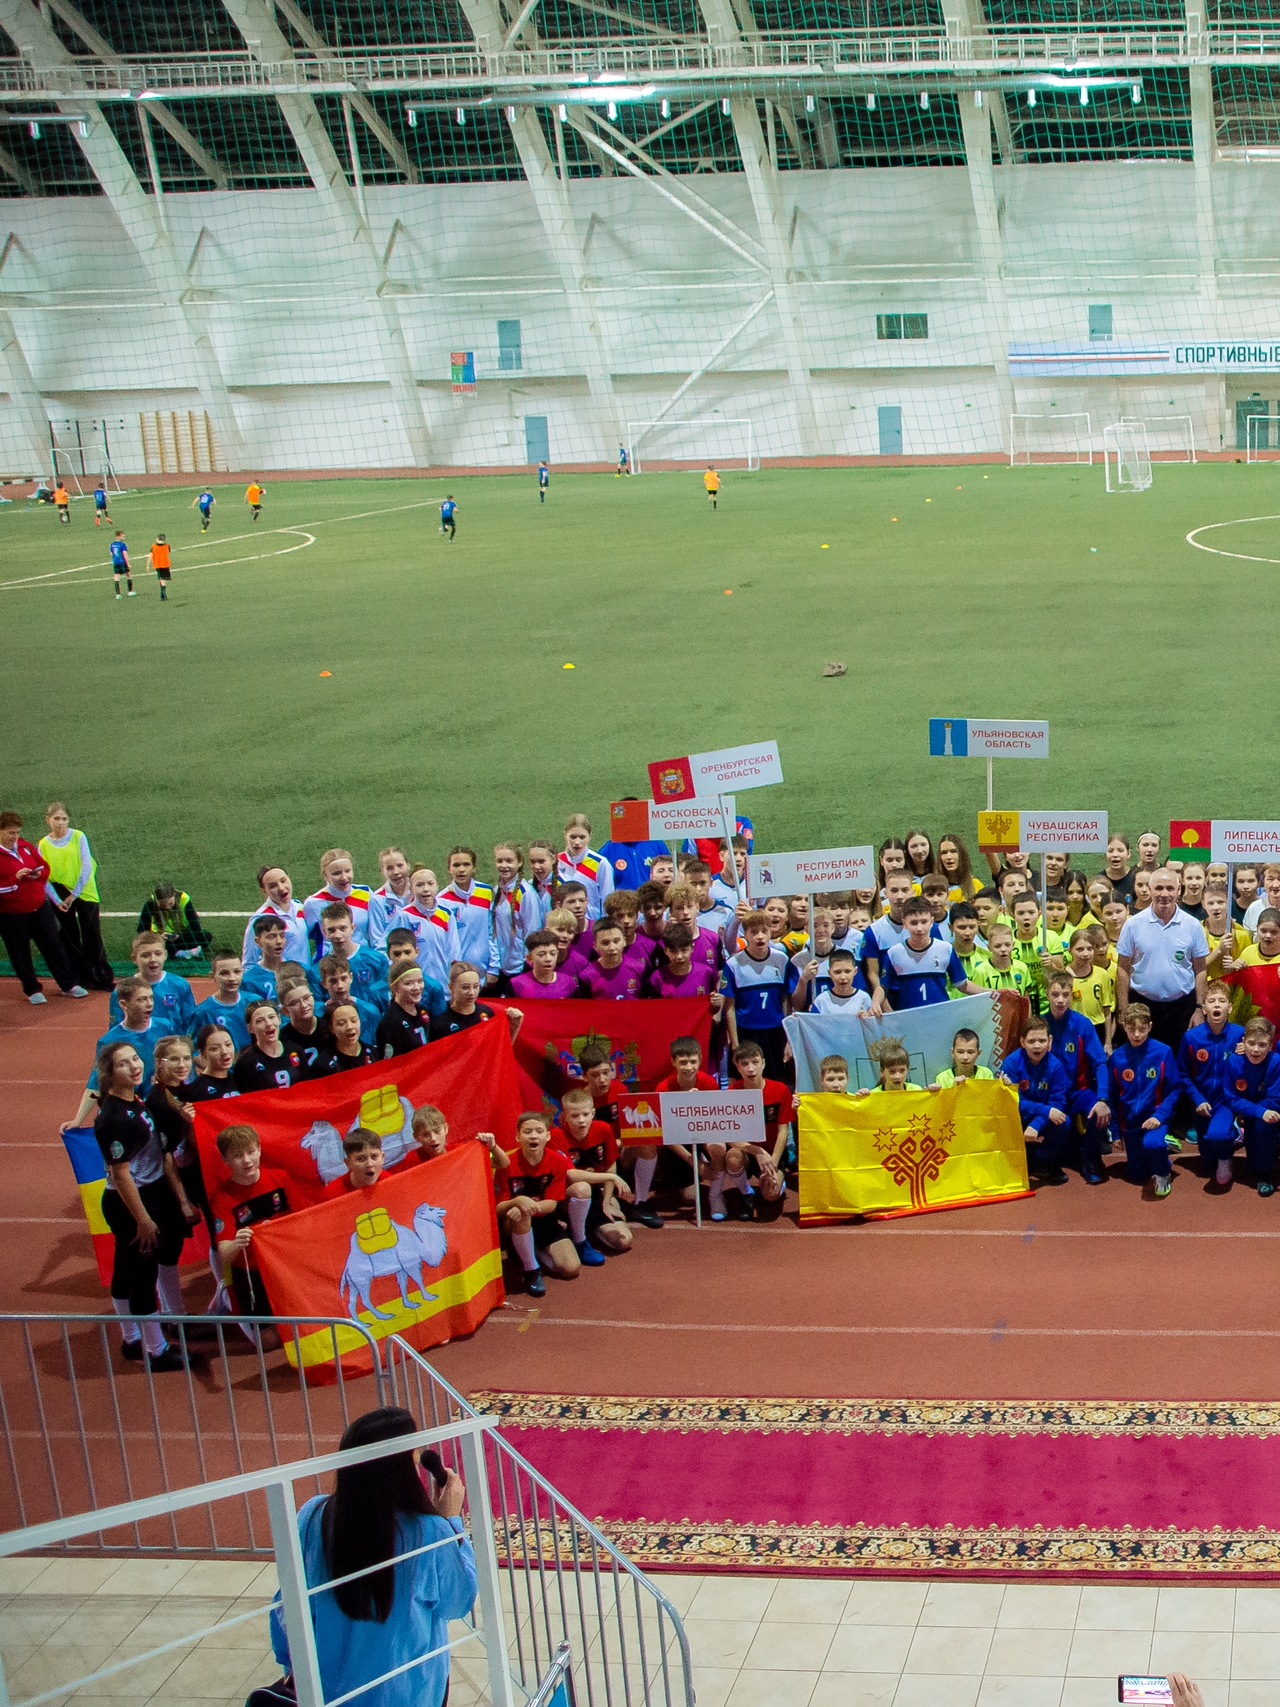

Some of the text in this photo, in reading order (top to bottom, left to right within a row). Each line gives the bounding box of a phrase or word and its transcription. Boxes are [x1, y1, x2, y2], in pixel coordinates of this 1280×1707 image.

[972, 730, 1045, 739] УЛЬЯНОВСКАЯ
[984, 740, 1031, 749] ОБЛАСТЬ
[700, 754, 774, 774] ОРЕНБУРГСКАЯ
[717, 768, 761, 782] ОБЛАСТЬ
[664, 819, 717, 830] ОБЛАСТЬ
[1027, 821, 1098, 830] ЧУВАШСКАЯ
[1026, 832, 1100, 842] РЕСПУБЛИКА
[796, 858, 866, 872] РЕСПУБЛИКА
[804, 869, 859, 883] МАРИЙ ЭЛ
[985, 975, 1000, 990] 17
[264, 982, 276, 1000] 2
[919, 982, 927, 1001] 1
[759, 992, 768, 1009] 7
[304, 1047, 318, 1066] 7
[274, 1070, 290, 1089] 9
[670, 1104, 755, 1118] ЧЕЛЯБИНСКАЯ
[687, 1120, 741, 1132] ОБЛАСТЬ
